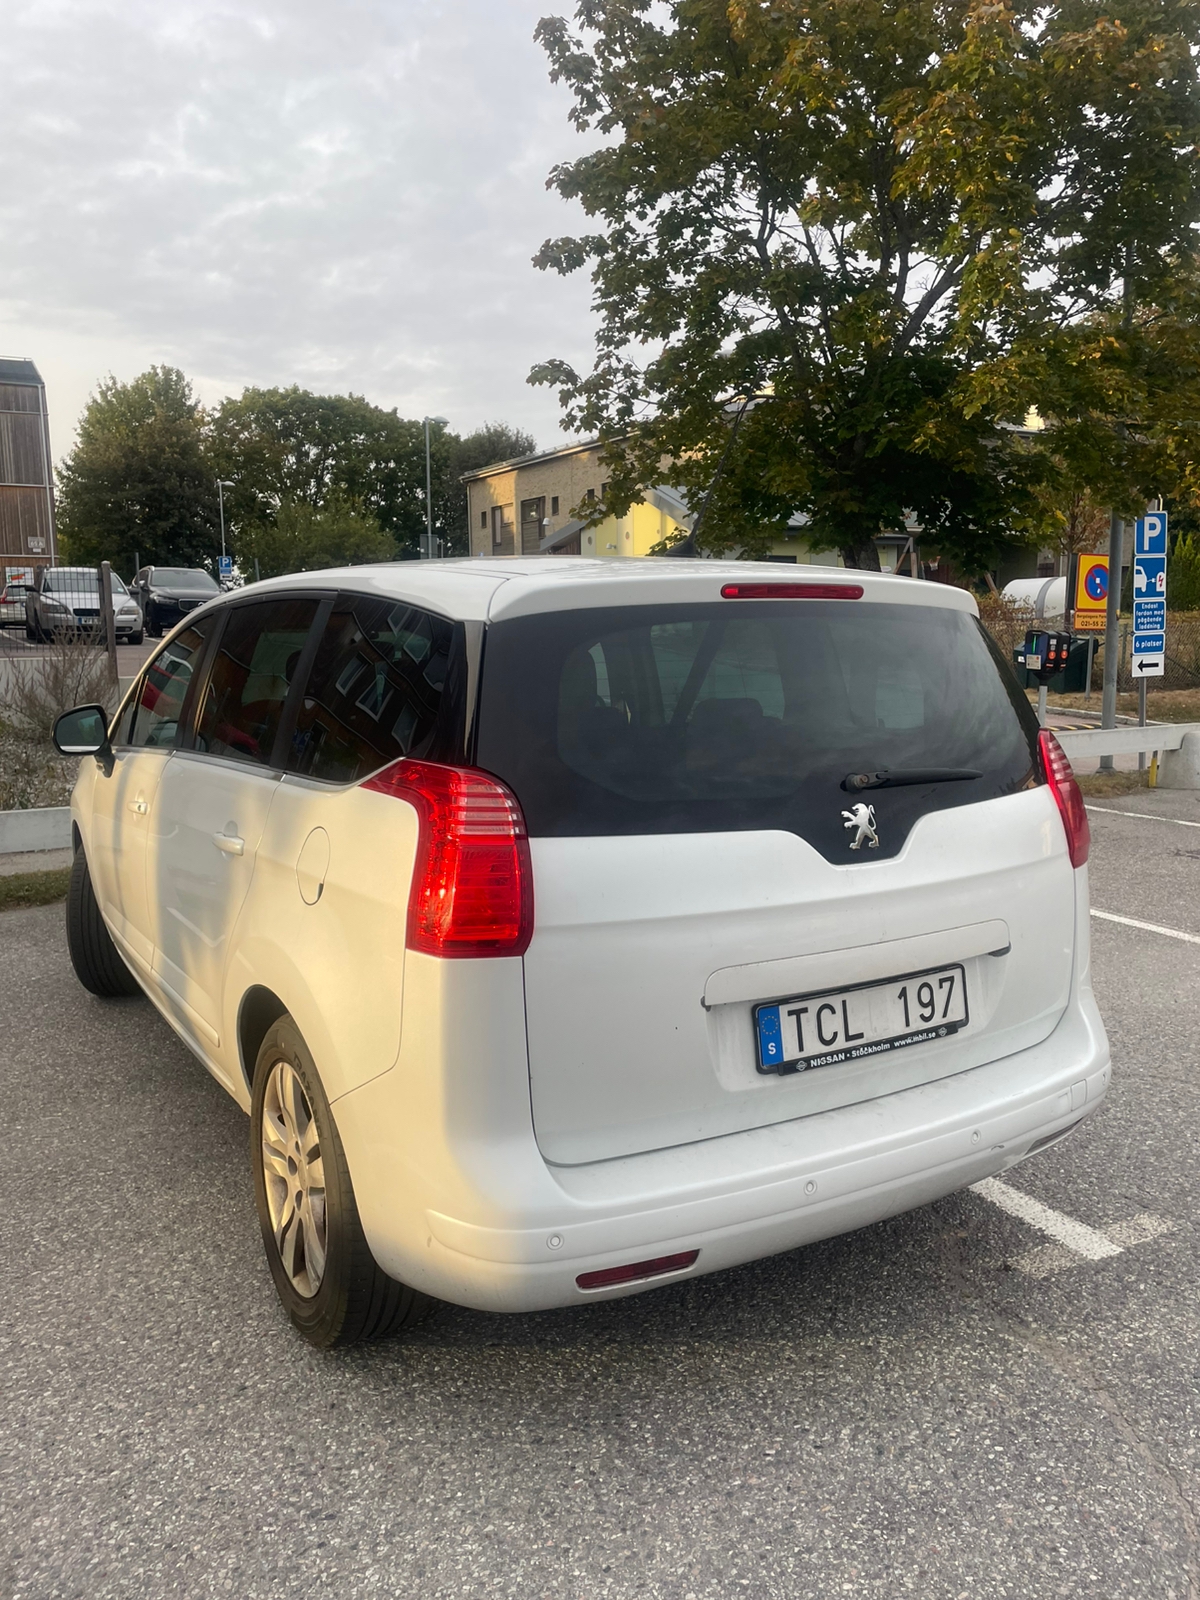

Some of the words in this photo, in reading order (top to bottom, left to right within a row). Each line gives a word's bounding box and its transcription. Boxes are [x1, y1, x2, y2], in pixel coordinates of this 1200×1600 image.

[1143, 516, 1162, 551] P
[222, 557, 230, 568] P
[1141, 640, 1162, 649] platser
[787, 999, 864, 1053] TCL
[897, 975, 955, 1028] 197
[767, 1042, 777, 1055] S
[810, 1052, 846, 1068] NISSAN
[293, 1051, 323, 1138] TRAZANO
